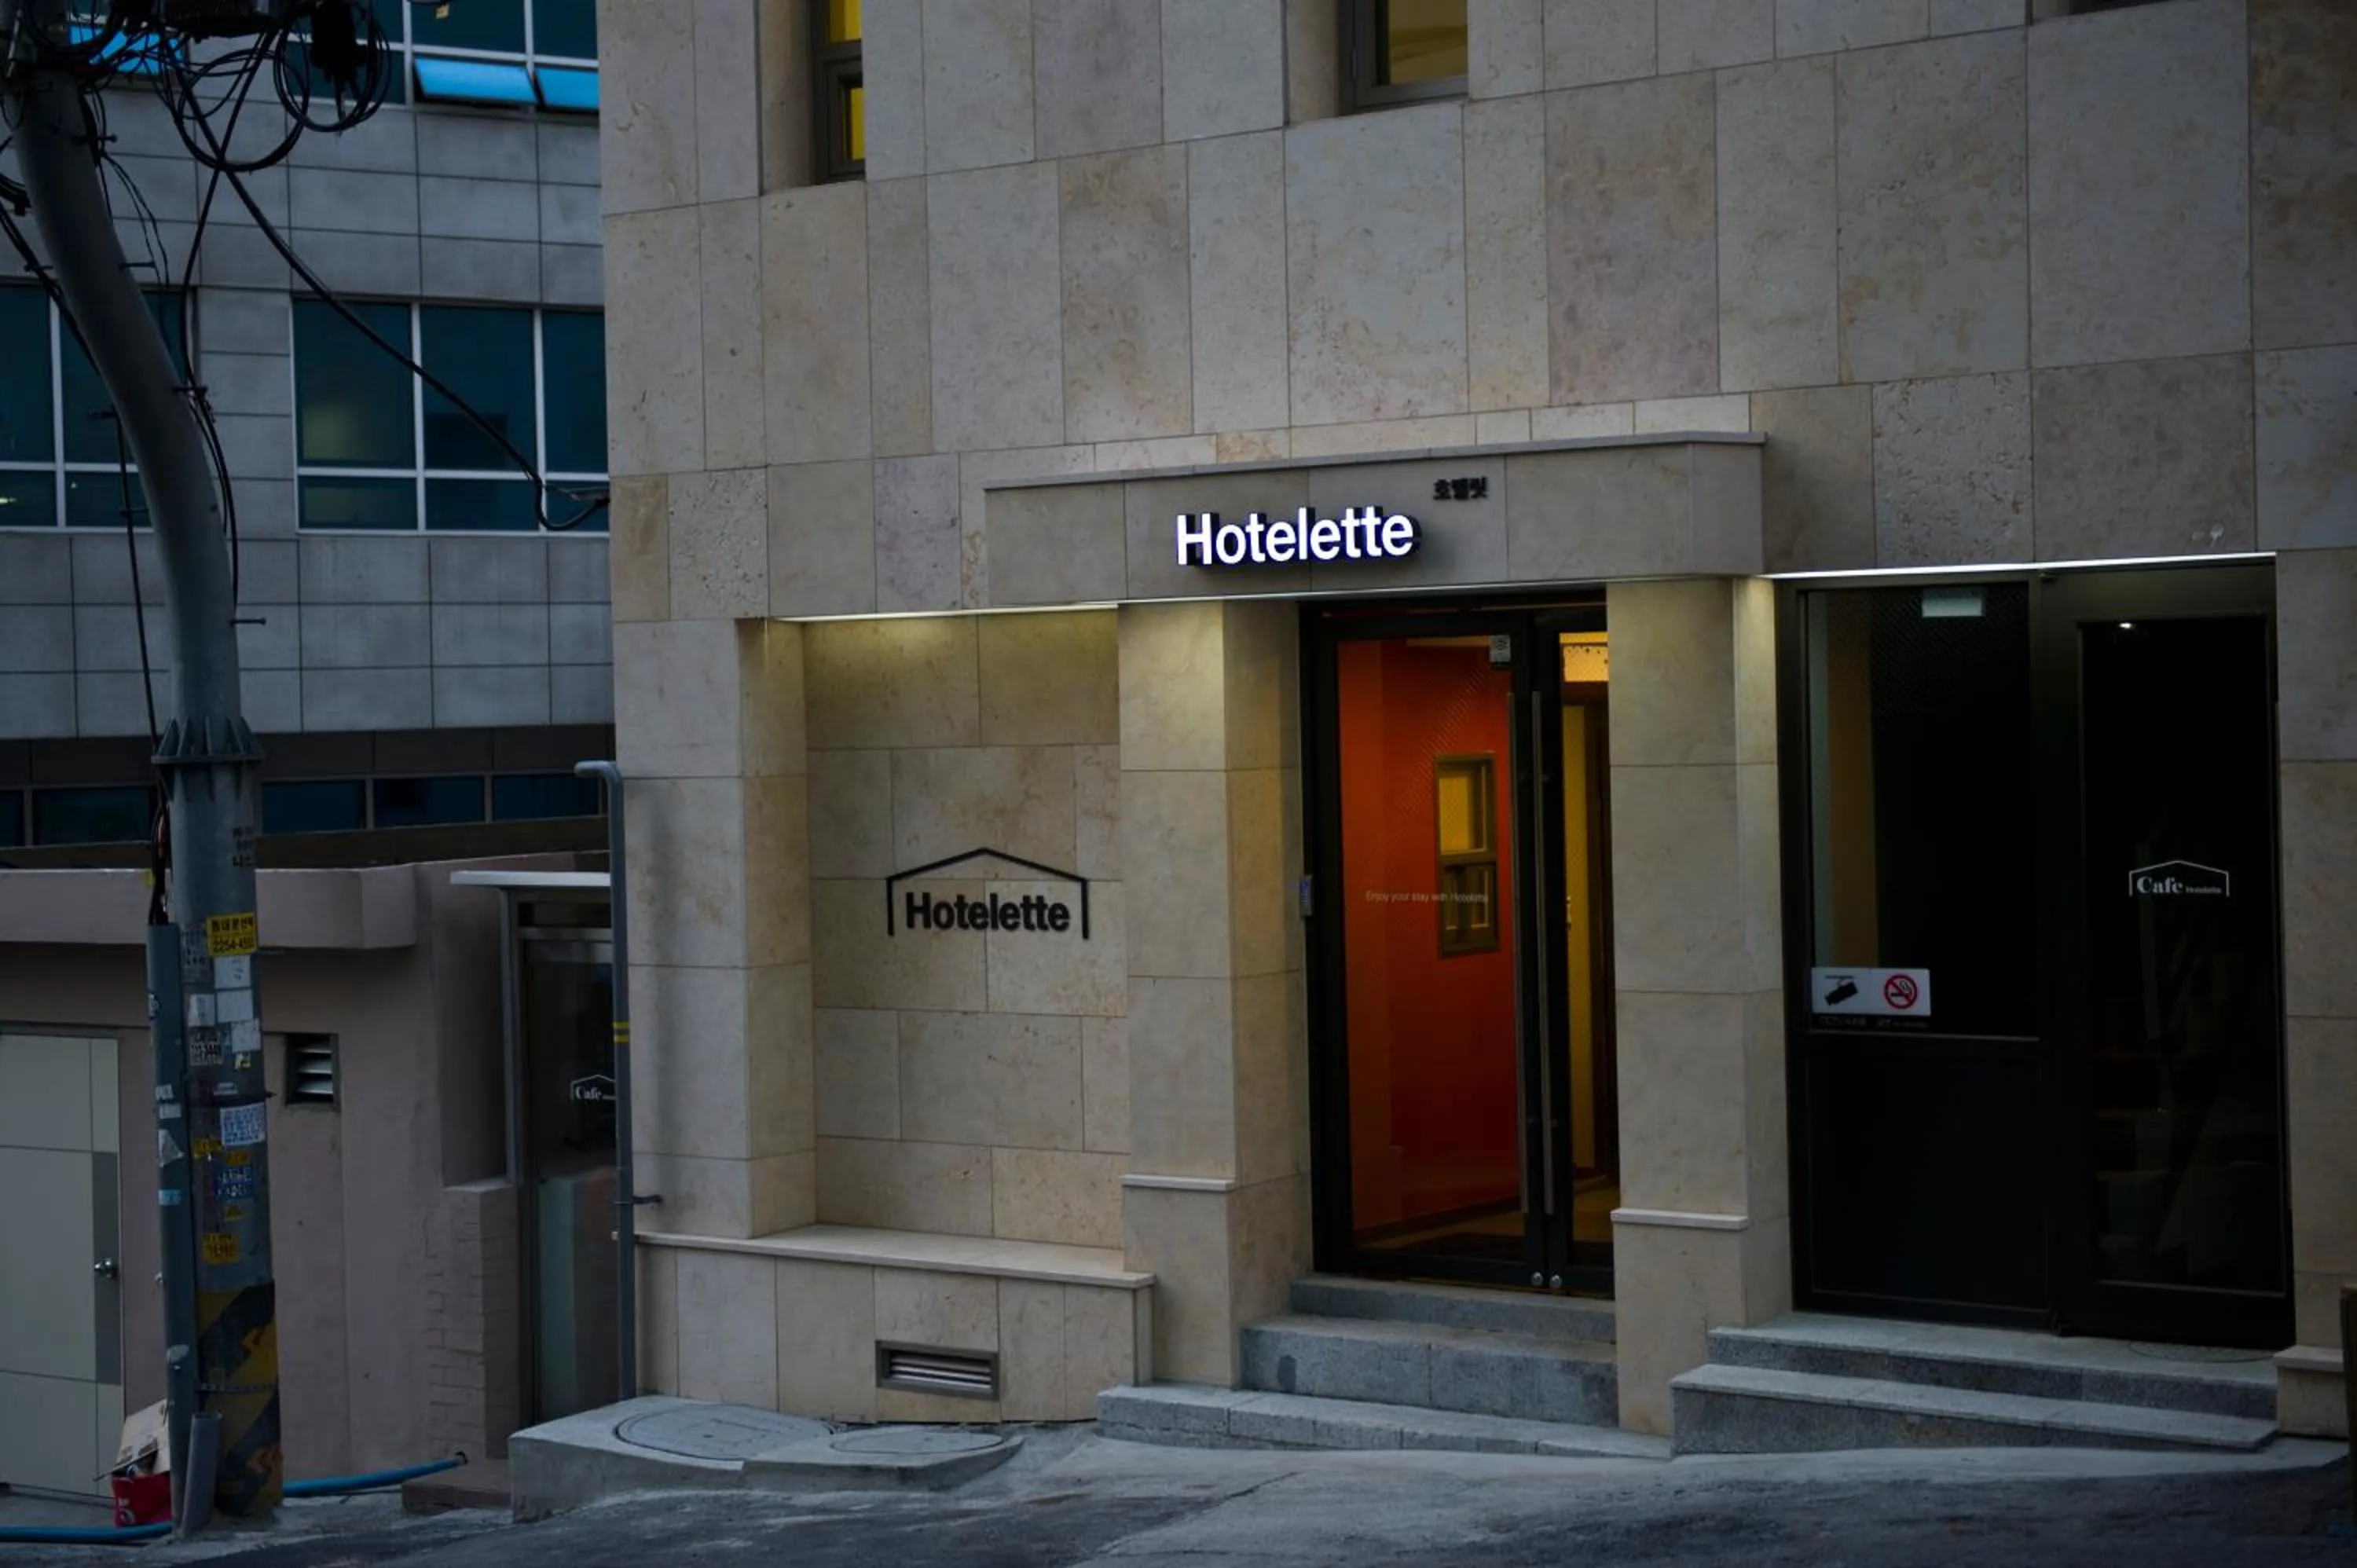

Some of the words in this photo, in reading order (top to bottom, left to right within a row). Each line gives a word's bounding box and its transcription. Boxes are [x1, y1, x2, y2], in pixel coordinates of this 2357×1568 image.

[1176, 505, 1417, 566] Hotelette
[2136, 875, 2183, 894] Cafe
[1365, 890, 1389, 903] Enjoy
[1391, 892, 1409, 903] your
[906, 892, 1070, 931] Hotelette
[575, 1086, 603, 1101] Cafe
